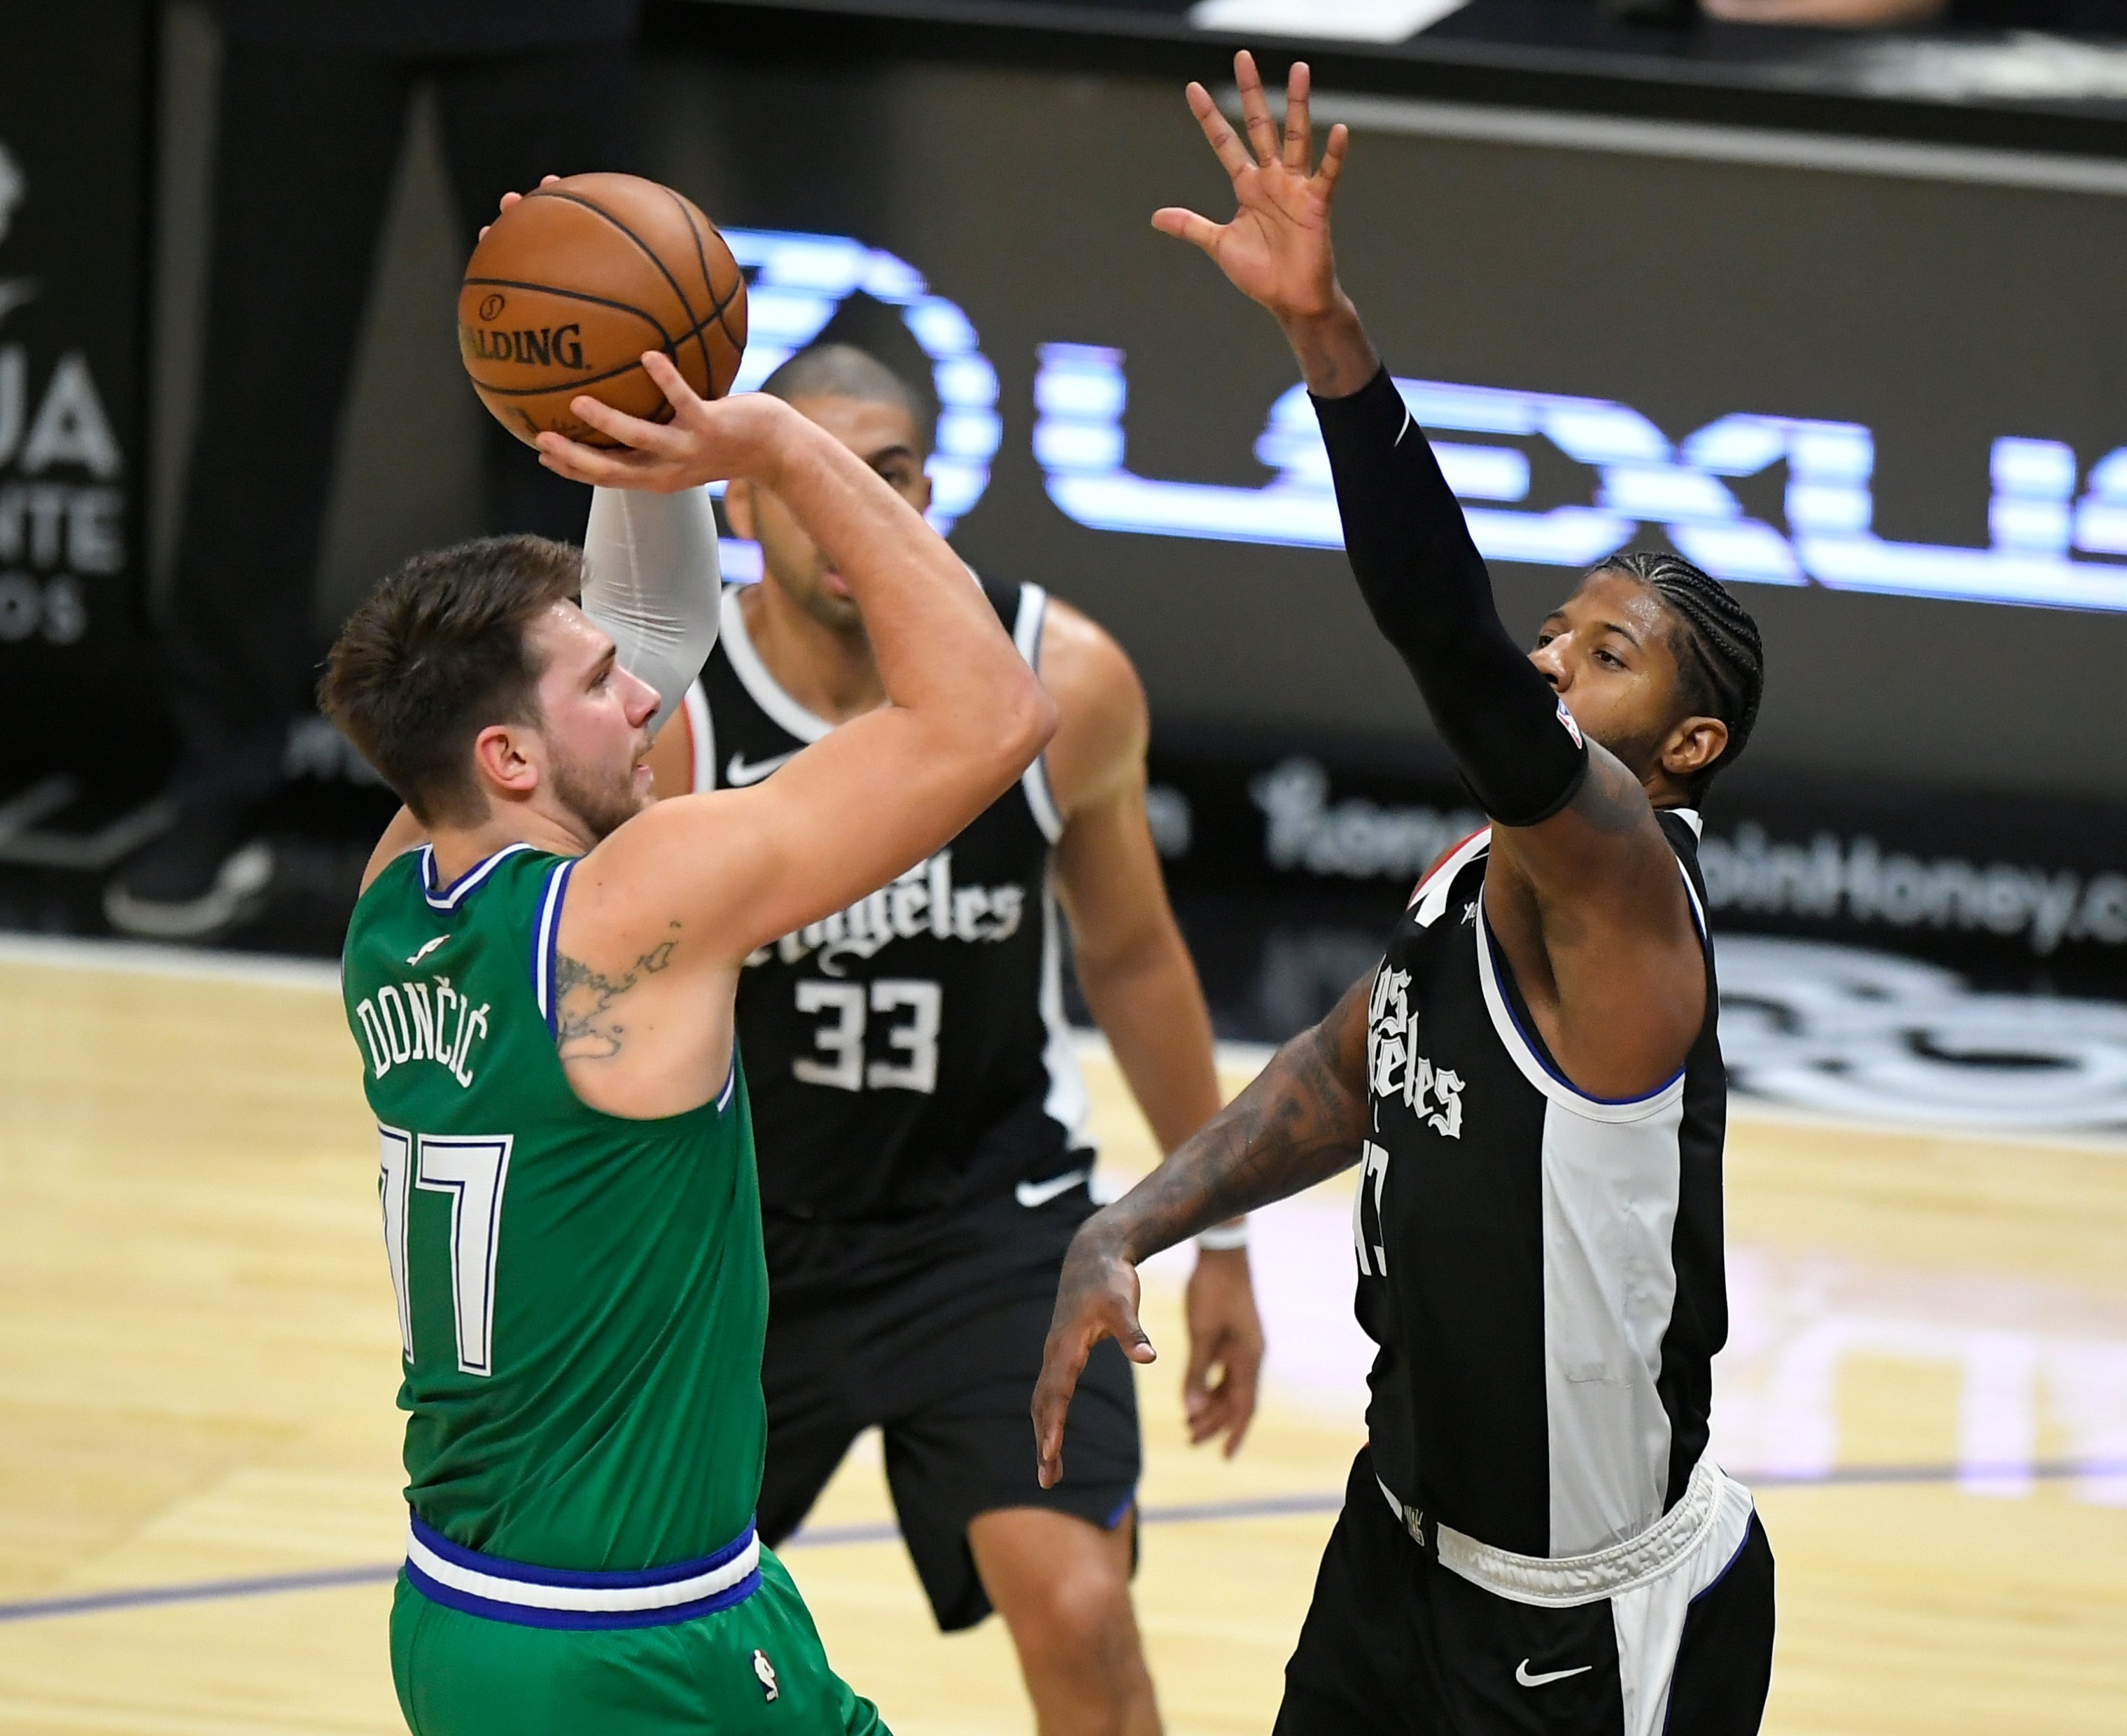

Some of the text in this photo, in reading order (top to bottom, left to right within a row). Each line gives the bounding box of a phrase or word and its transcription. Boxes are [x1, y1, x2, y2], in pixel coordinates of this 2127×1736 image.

[462, 324, 584, 370] LDING
[1032, 342, 2127, 613] LEXU
[743, 847, 1025, 977] geles
[1697, 822, 2127, 954] oinHoney.c
[356, 974, 491, 1088] DONČIĆ
[792, 981, 943, 1093] 33
[1367, 1010, 1466, 1140] eles
[379, 1120, 514, 1378] 77
